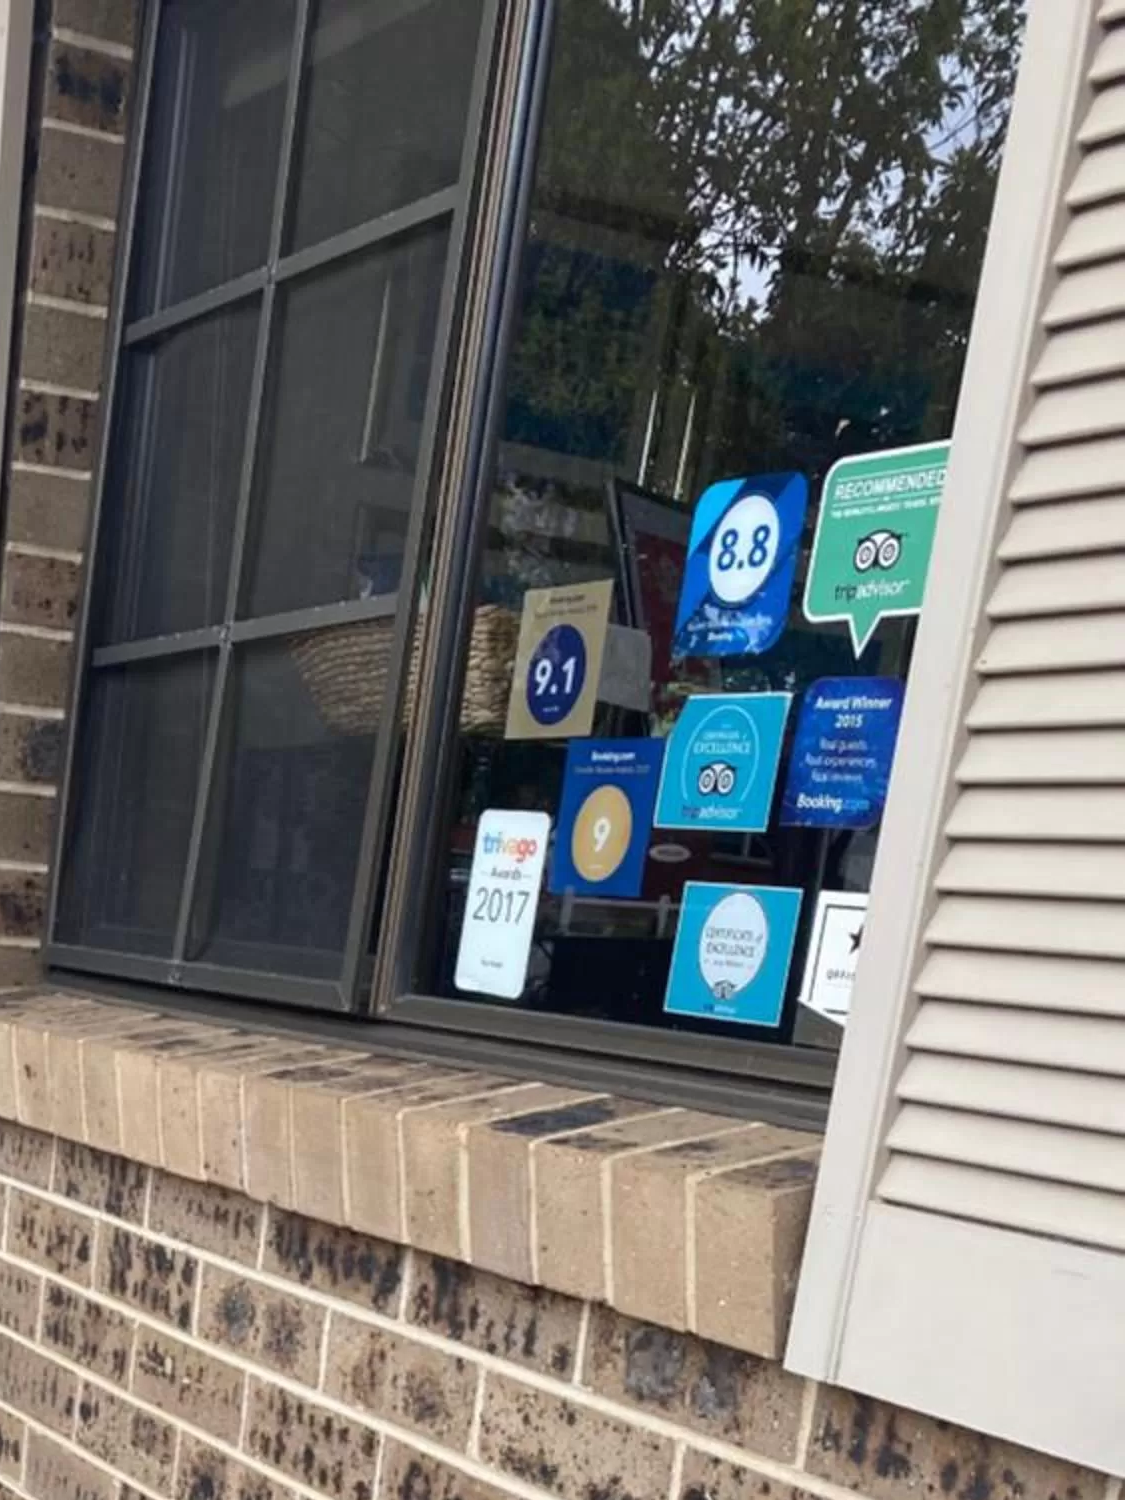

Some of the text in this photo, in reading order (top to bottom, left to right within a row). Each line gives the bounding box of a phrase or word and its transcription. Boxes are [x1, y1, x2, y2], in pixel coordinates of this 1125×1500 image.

[717, 524, 771, 571] 8.8
[835, 579, 906, 602] tripadvisor
[534, 656, 577, 696] 9.1
[815, 695, 892, 709] Award Winner
[835, 714, 864, 728] 2015
[693, 741, 751, 754] EXCELLENCE
[482, 832, 538, 862] trivago
[593, 816, 612, 852] 9
[491, 866, 522, 881] Awards
[473, 887, 530, 924] 2017
